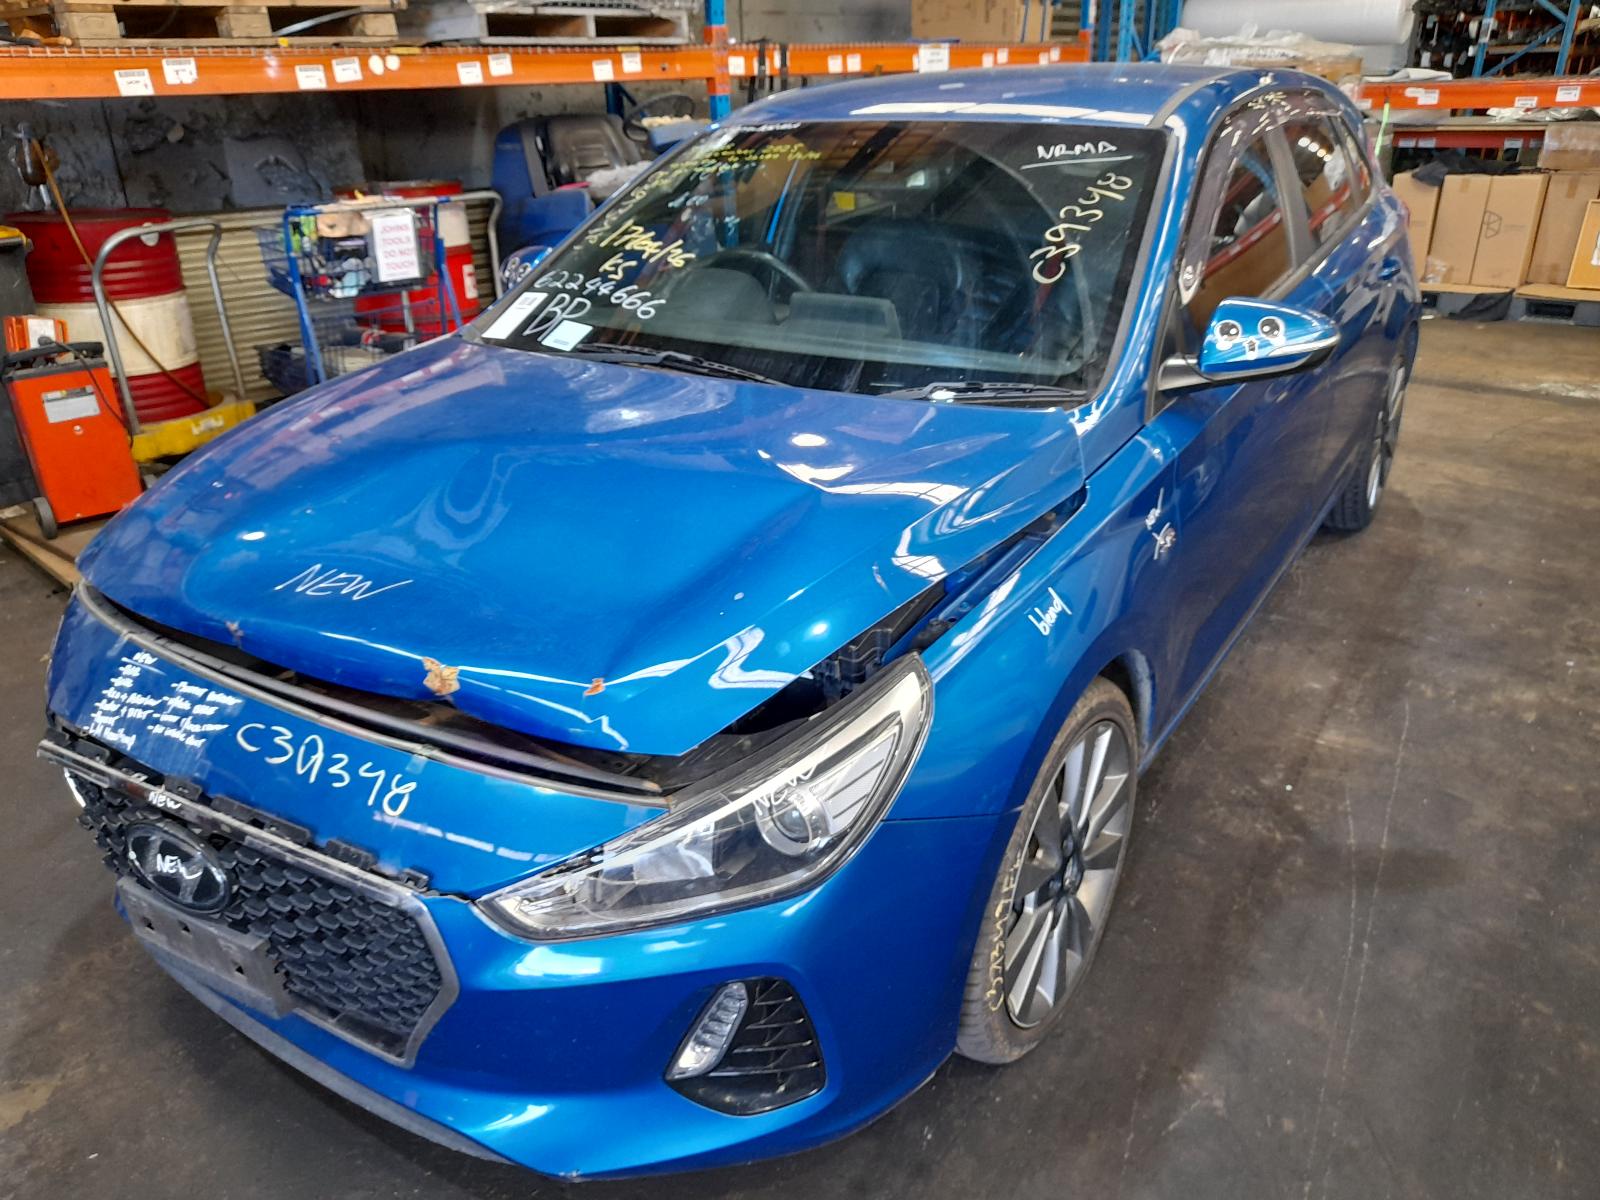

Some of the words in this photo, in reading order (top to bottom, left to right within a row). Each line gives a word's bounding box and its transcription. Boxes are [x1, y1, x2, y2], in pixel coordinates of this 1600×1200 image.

[1036, 141, 1118, 160] NRMA
[272, 562, 415, 601] NEW
[148, 790, 183, 810] NEW
[156, 852, 204, 880] NEW
